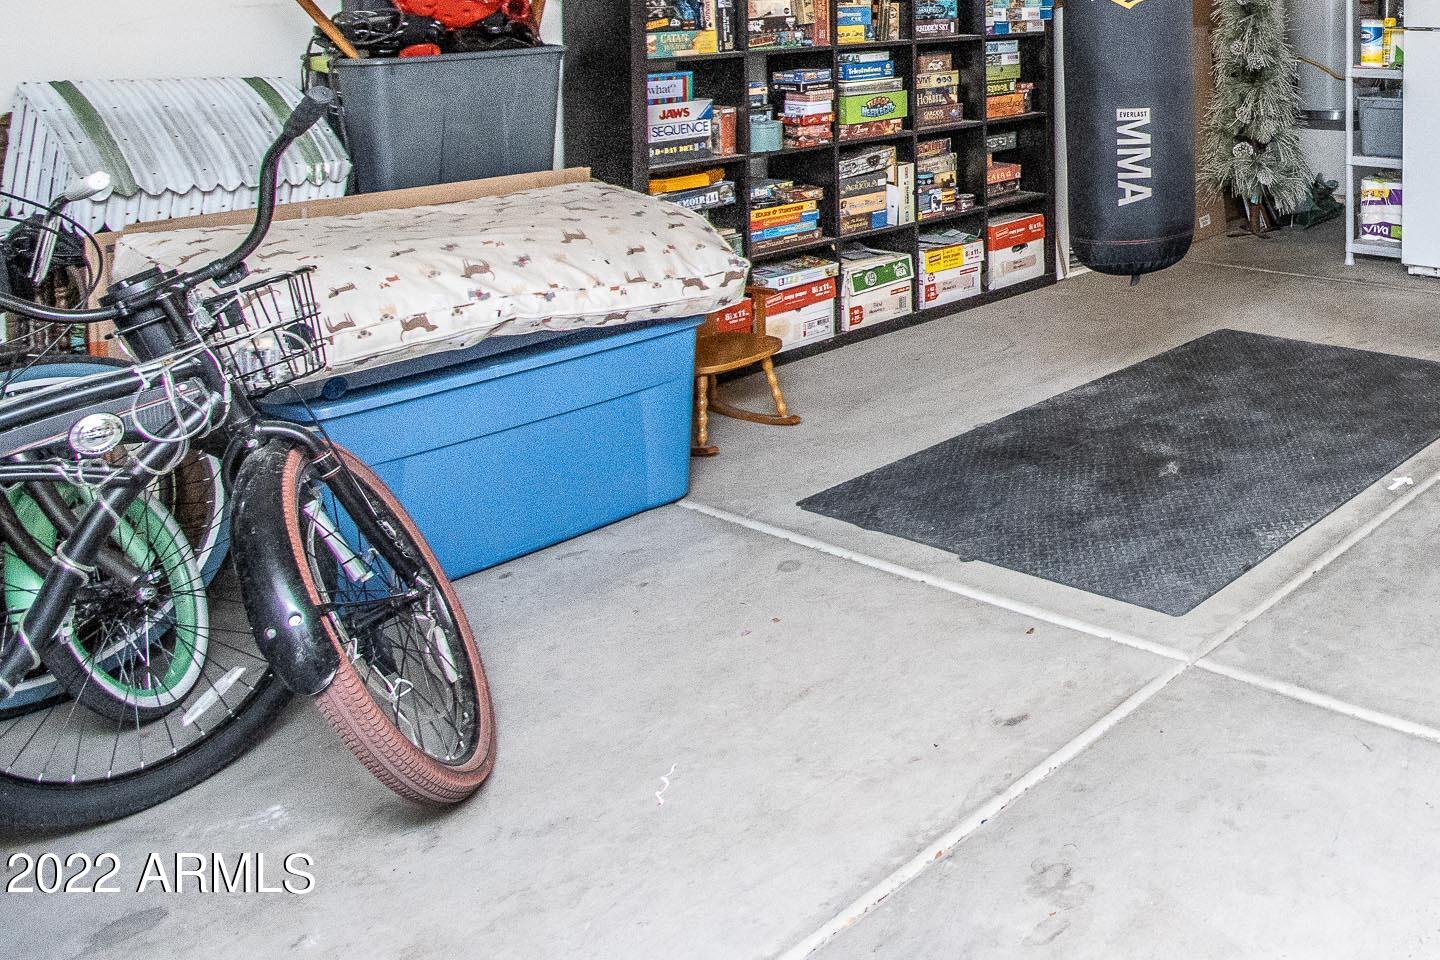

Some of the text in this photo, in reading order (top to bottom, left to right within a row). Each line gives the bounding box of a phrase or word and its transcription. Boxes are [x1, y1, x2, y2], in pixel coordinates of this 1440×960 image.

[659, 107, 690, 120] JAWS
[1119, 110, 1147, 118] EVERLAST
[651, 121, 709, 138] SEQUENCE
[1116, 119, 1152, 207] MMA
